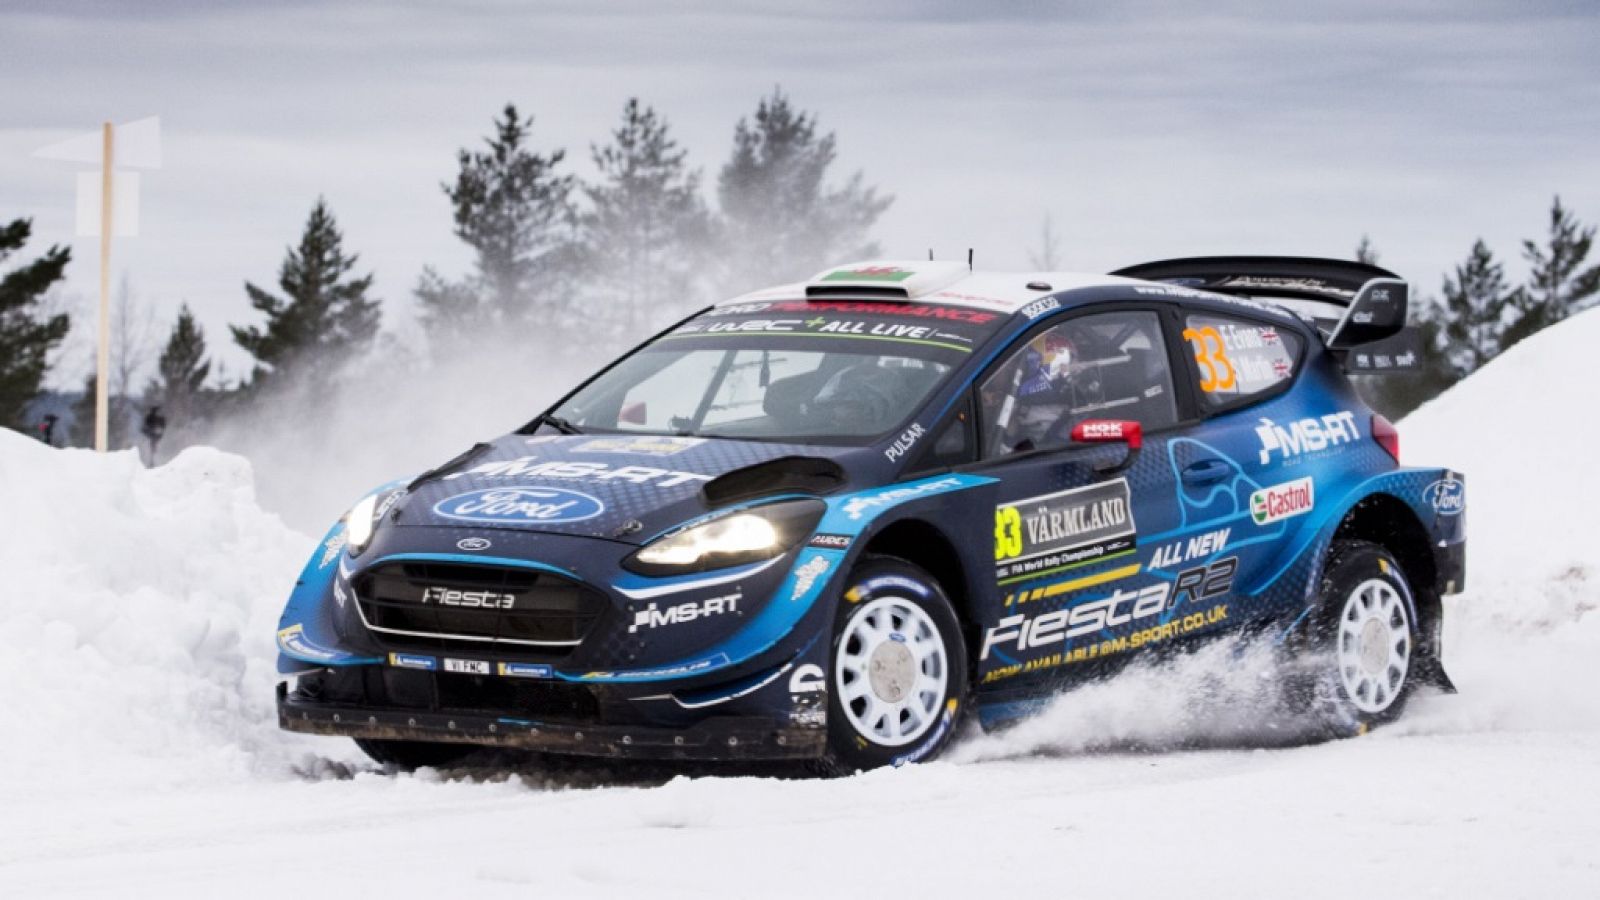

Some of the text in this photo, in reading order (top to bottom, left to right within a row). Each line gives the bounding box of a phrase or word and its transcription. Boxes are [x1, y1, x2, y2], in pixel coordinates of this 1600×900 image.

[819, 320, 865, 333] ALL
[870, 322, 930, 338] LIVE
[1182, 326, 1236, 392] 33
[885, 422, 926, 463] PULSAR
[1272, 410, 1360, 458] MS-RT
[455, 488, 578, 519] Ford
[1267, 482, 1311, 518] Castrol
[1433, 482, 1462, 509] Ford
[1027, 498, 1126, 545] VÄRMLAND
[1024, 560, 1043, 572] World
[1044, 556, 1060, 567] Rally
[1061, 545, 1104, 561] Championship
[1148, 527, 1232, 571] ALL NEW
[649, 594, 743, 629] MS-RT
